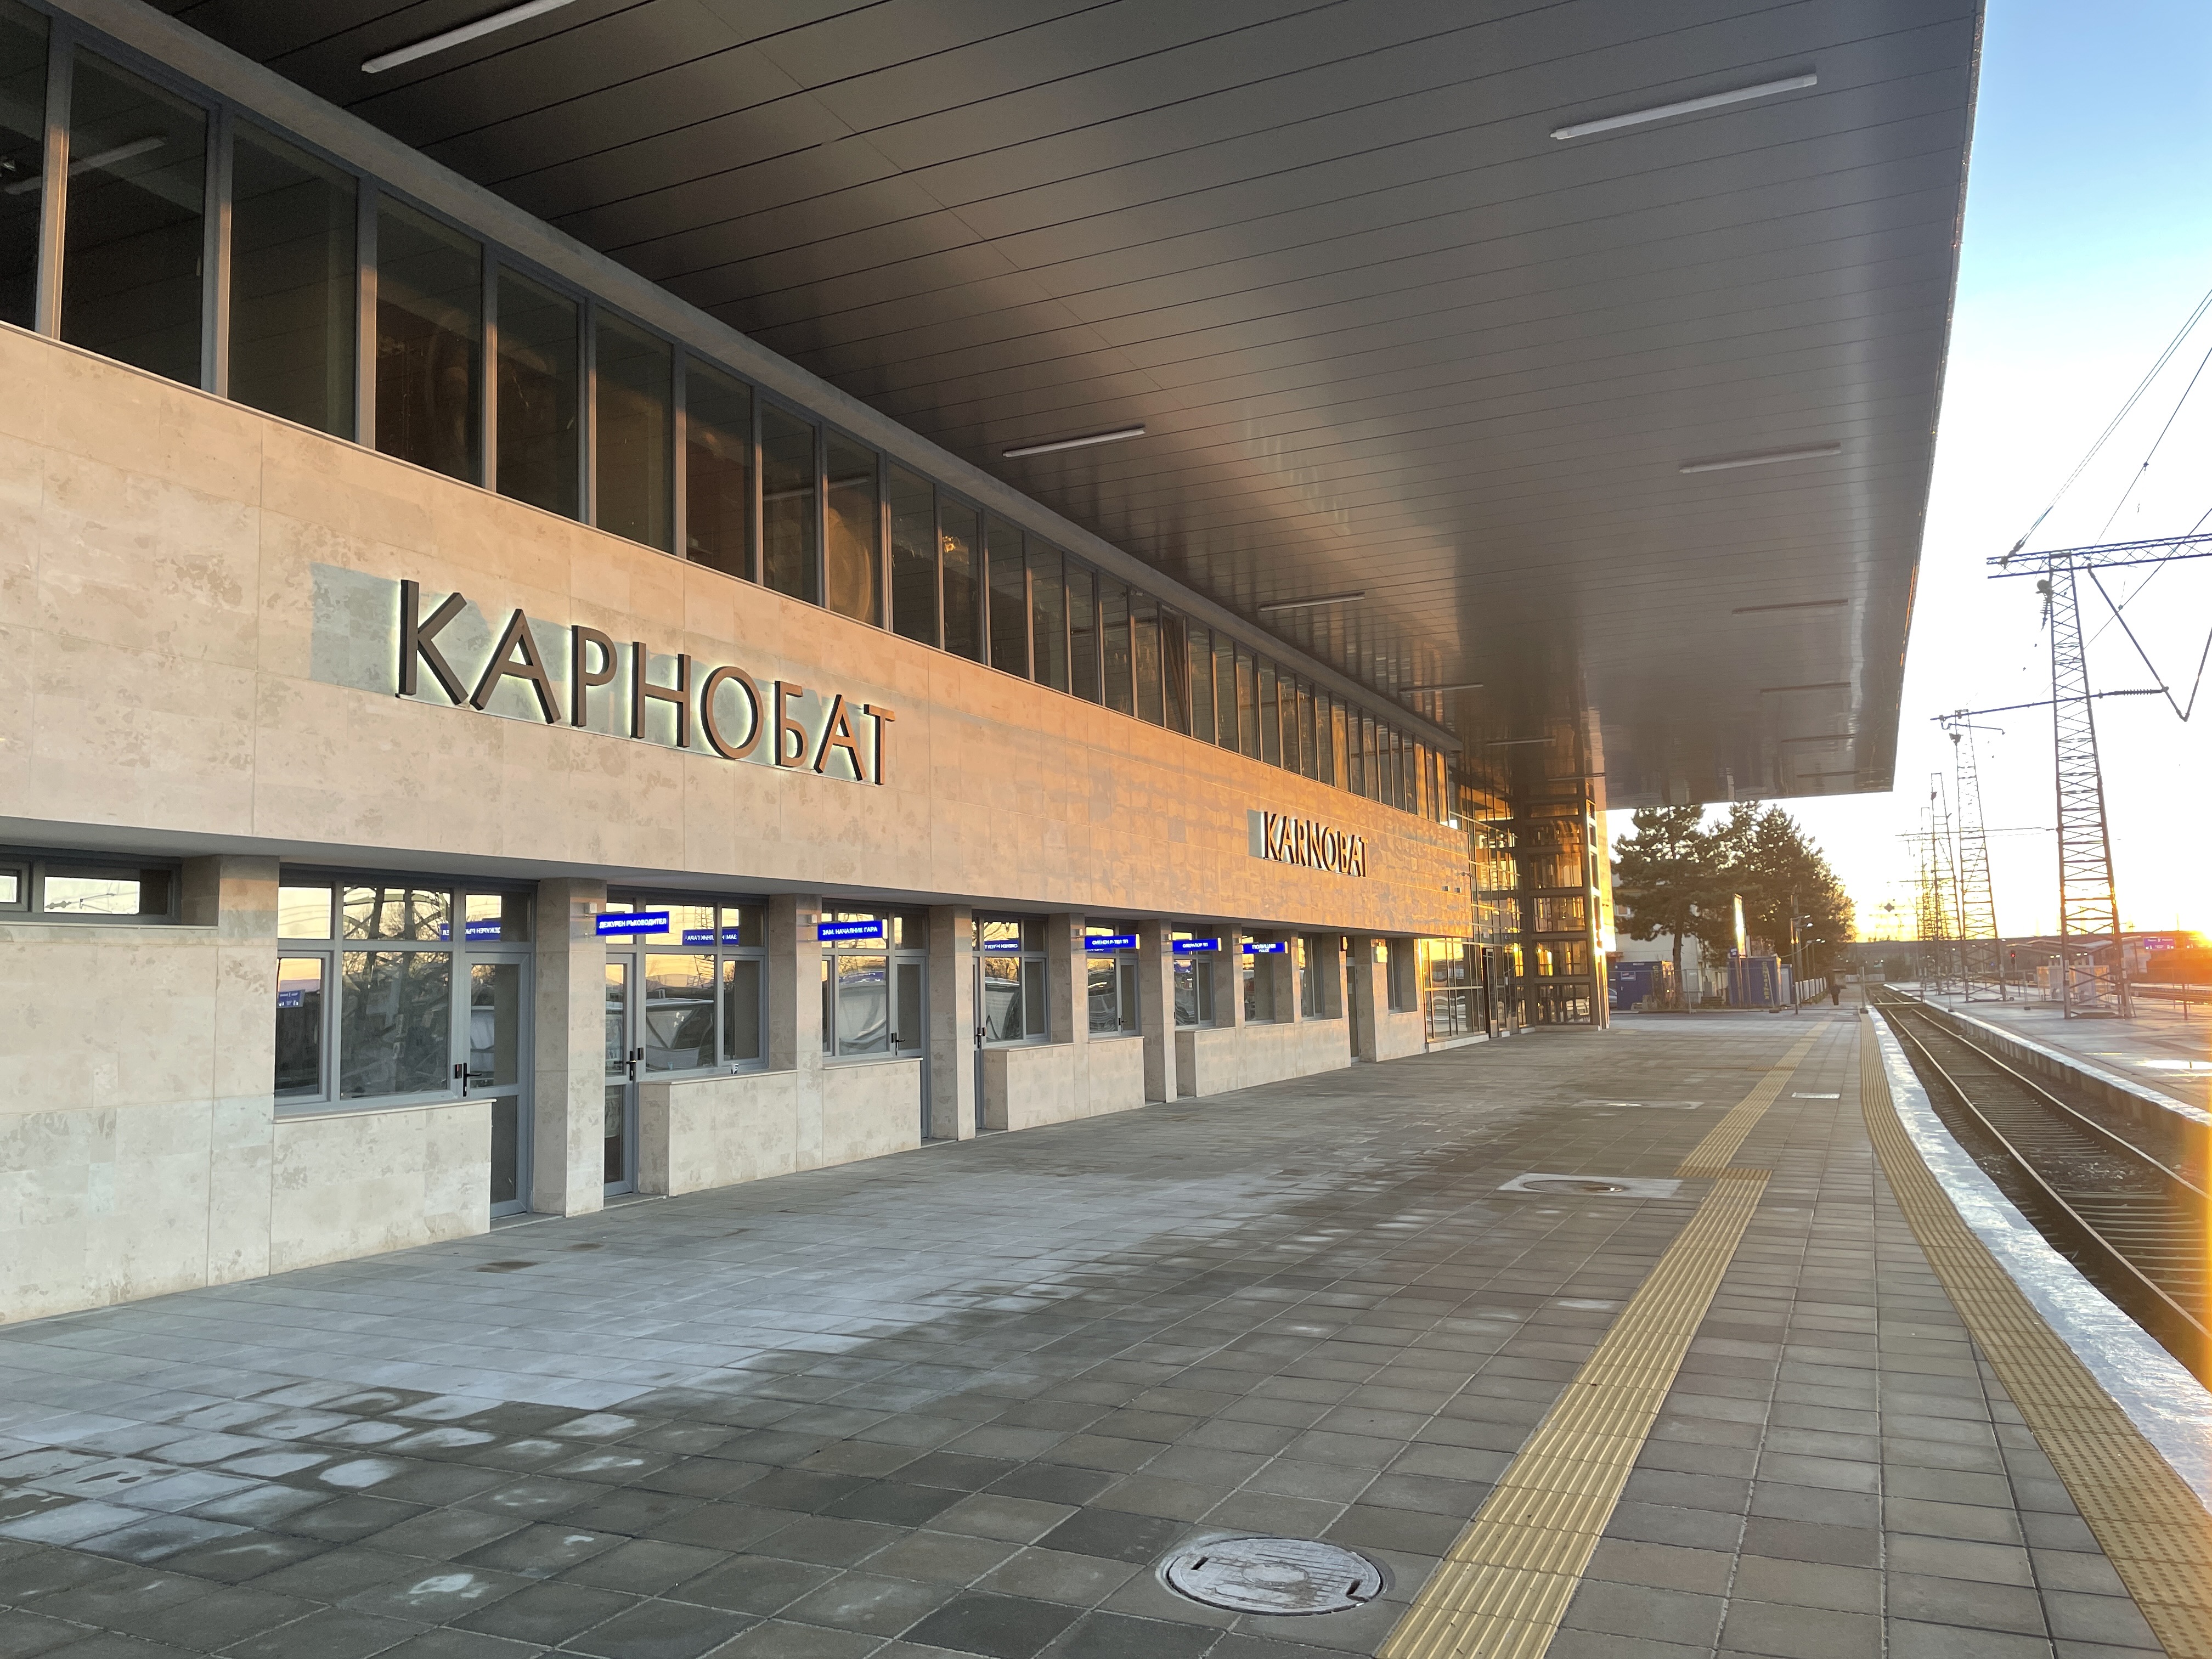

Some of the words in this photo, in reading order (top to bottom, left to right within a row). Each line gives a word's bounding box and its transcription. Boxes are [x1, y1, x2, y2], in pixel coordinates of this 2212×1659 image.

[398, 579, 895, 786] КАРНОБАТ
[1263, 811, 1369, 878] KARNOBAT
[599, 921, 625, 929] ДЕЖУРЕН
[626, 918, 667, 926] РЪКОВОДИТЕЛ
